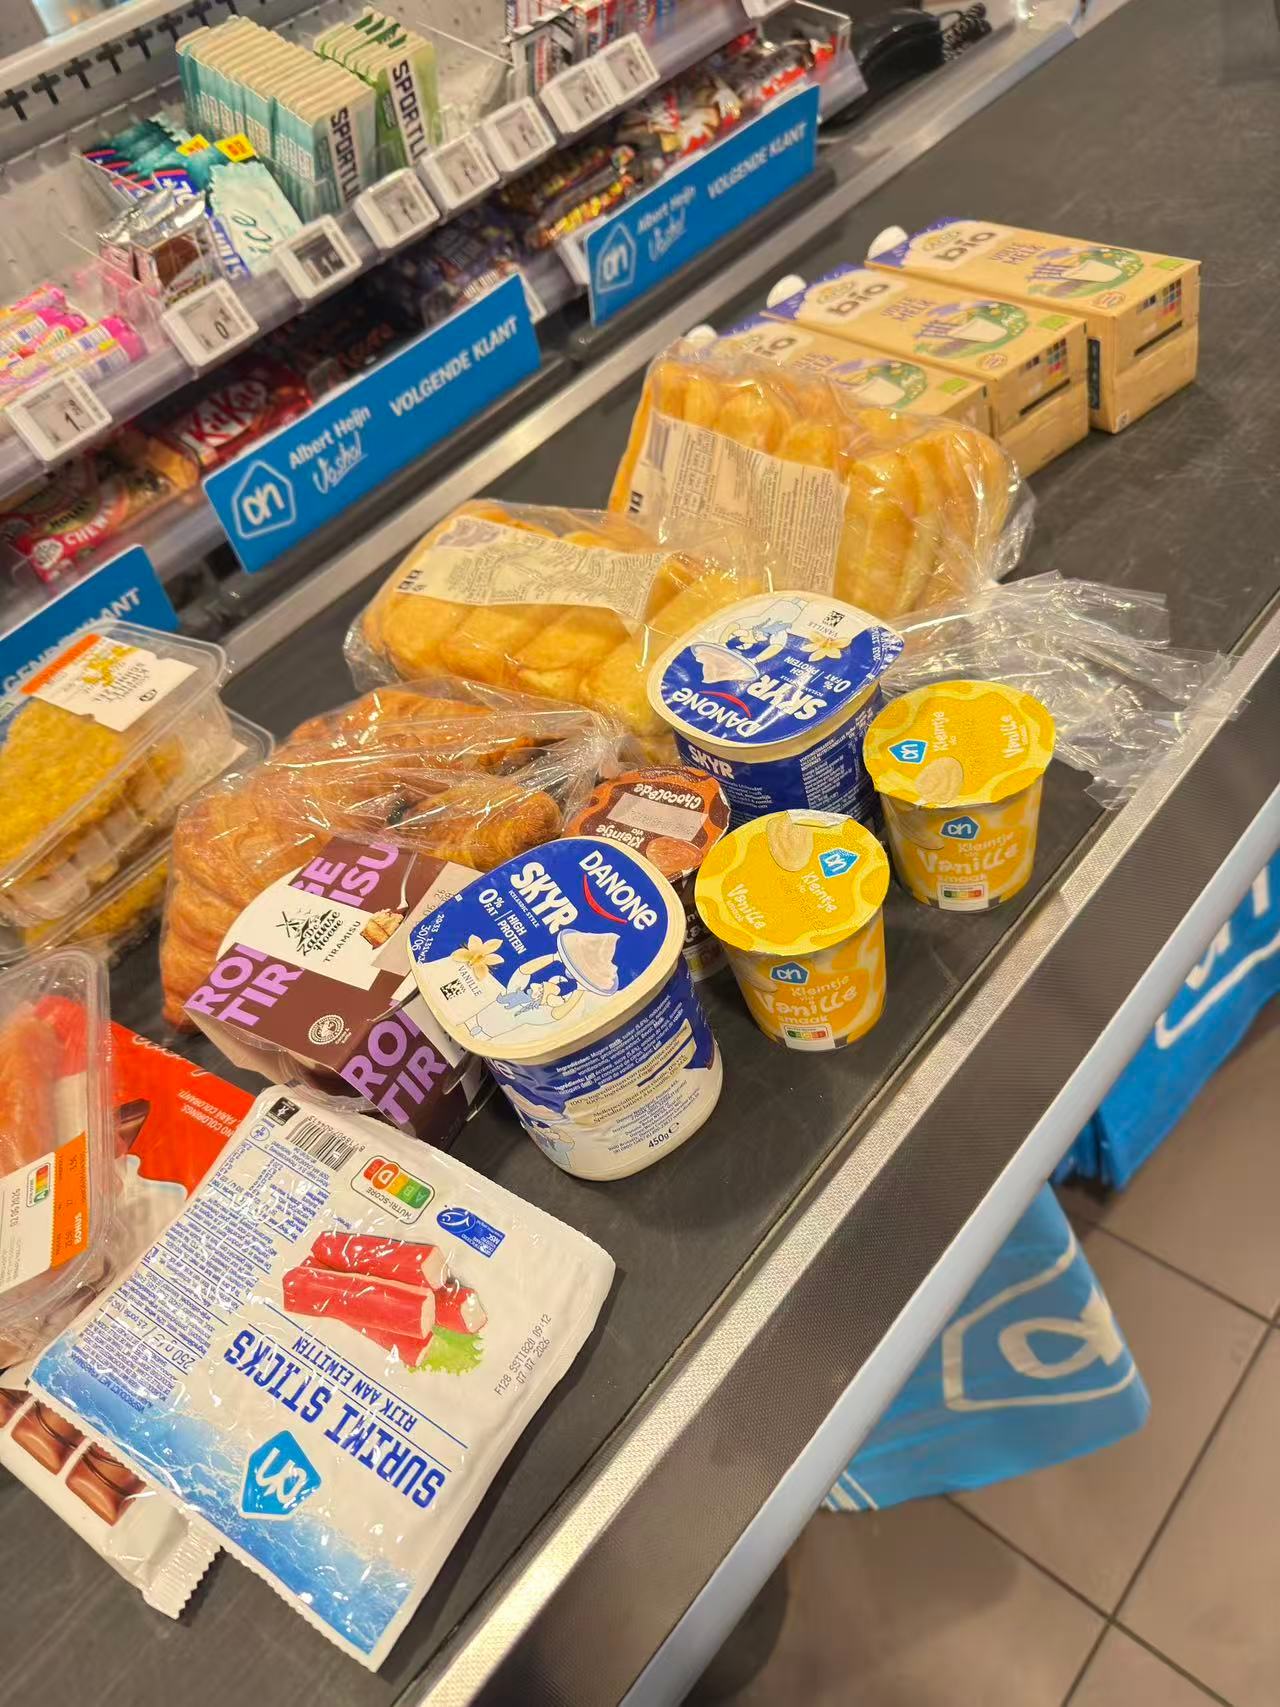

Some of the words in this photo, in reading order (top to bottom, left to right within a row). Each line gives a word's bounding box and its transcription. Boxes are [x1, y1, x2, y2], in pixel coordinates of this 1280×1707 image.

[706, 151, 769, 199] VOLGENDE
[766, 122, 809, 160] KLANT
[931, 231, 999, 262] bio
[827, 283, 891, 317] bio
[388, 348, 472, 418] VOLGENDE
[472, 315, 521, 362] KLANT
[288, 429, 337, 470] Albert
[333, 405, 372, 438] Heijn
[806, 616, 839, 642] VANILLE
[783, 651, 820, 679] PROTEIN
[824, 670, 841, 685] FAT
[746, 674, 828, 720] SKYR
[932, 710, 951, 752] Kleintje
[999, 714, 1025, 759] Vanille
[687, 744, 735, 780] SKYR
[632, 782, 702, 809] Chocolade
[593, 822, 645, 849] Kleintje
[917, 844, 1019, 874] Vanille
[510, 861, 578, 935] SKYR
[578, 849, 659, 931] DANONE
[727, 883, 767, 930] Vanille
[801, 871, 839, 913] Kleintje
[484, 901, 498, 917] FAT
[506, 913, 526, 936] HIGH
[525, 911, 539, 928] STYLE
[297, 909, 341, 956] Zaanse
[303, 922, 319, 939] De
[312, 918, 344, 952] Hoeve
[321, 919, 362, 964] TIRAMISU
[410, 922, 431, 952] 30/06
[496, 918, 526, 955] PROTEIN
[457, 964, 481, 997] VANILLE
[791, 976, 849, 996] Kleintje
[756, 984, 858, 1017] Vanille
[778, 1015, 829, 1025] smaak
[646, 1131, 670, 1149] 450g
[376, 1166, 392, 1183] D
[363, 1185, 413, 1219] NUTRI-SCORE
[486, 1232, 500, 1244] MSC
[170, 1347, 195, 1371] 250
[291, 1336, 354, 1387] EIWITTEN
[514, 1371, 528, 1384] 07
[523, 1357, 536, 1370] 07
[532, 1336, 551, 1357] 2026
[223, 1328, 338, 1424] STICKS
[351, 1375, 382, 1406] AAN
[493, 1373, 512, 1395] F128
[379, 1398, 418, 1433] RIJK
[323, 1401, 447, 1509] SURIMI
